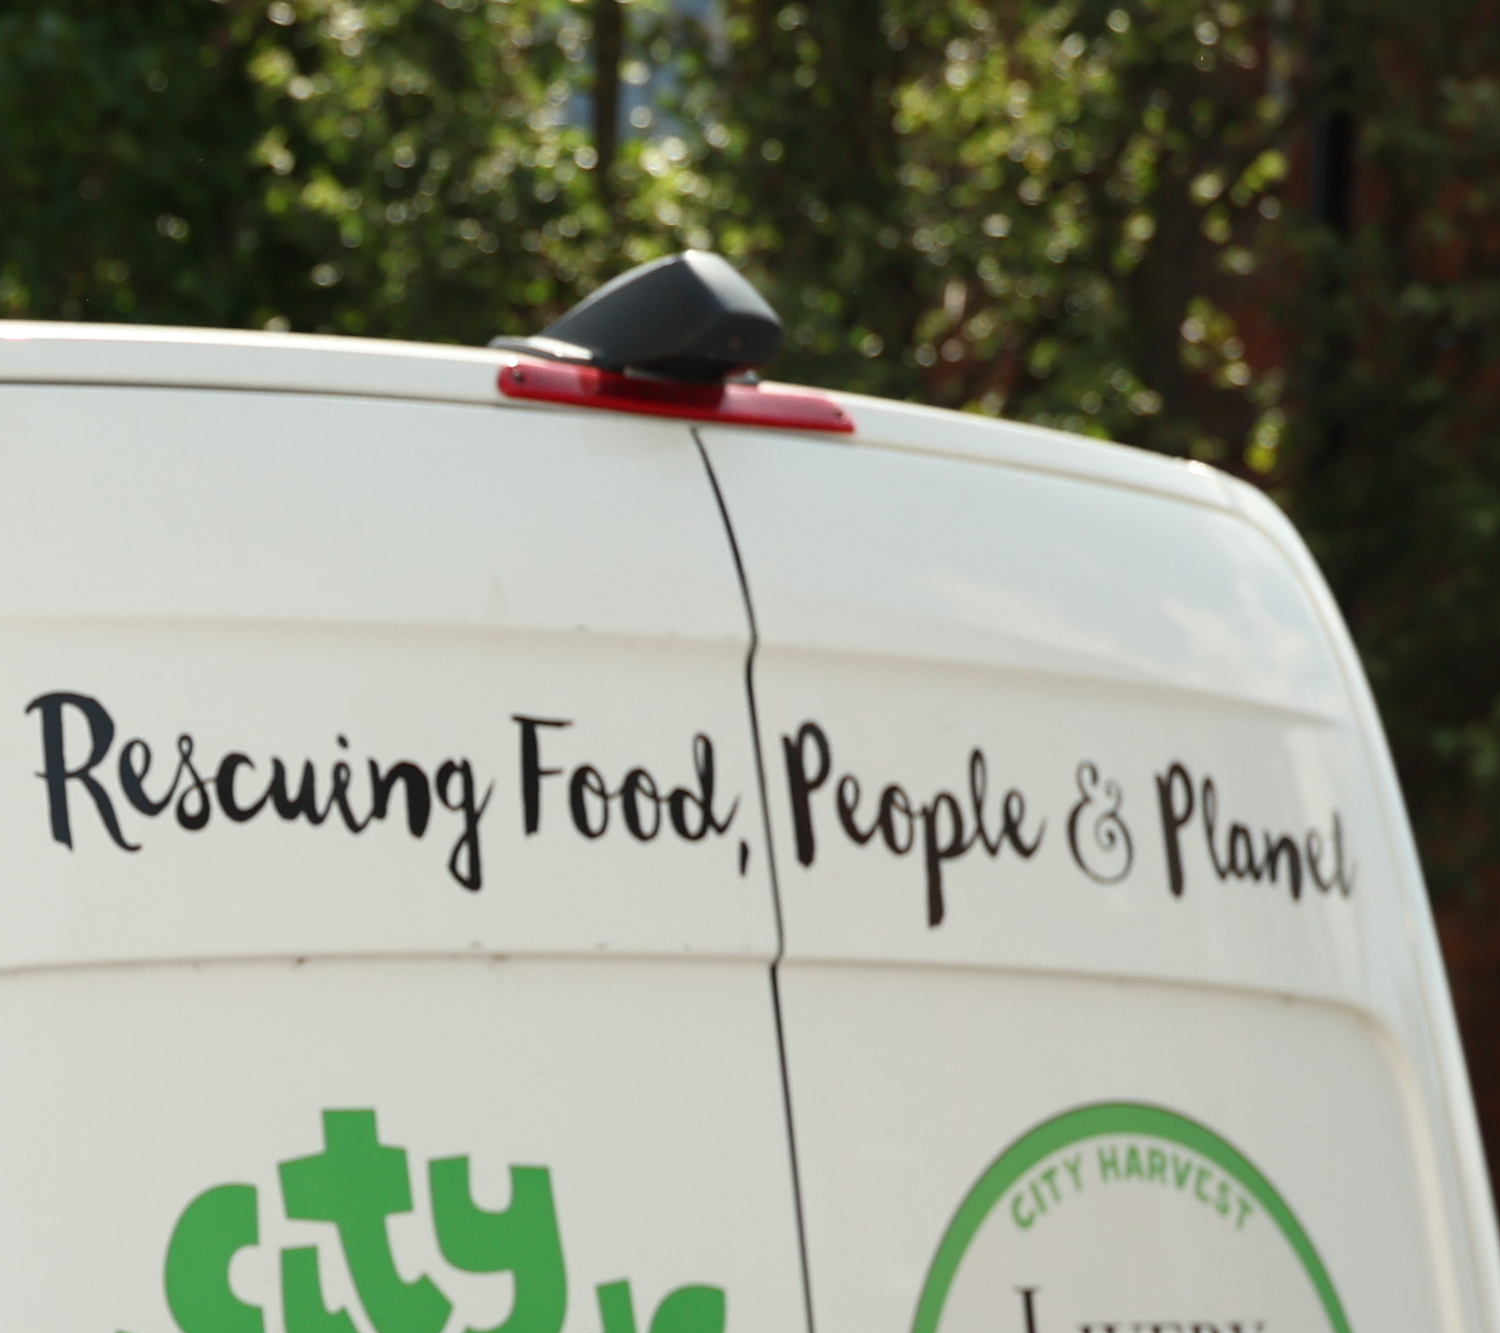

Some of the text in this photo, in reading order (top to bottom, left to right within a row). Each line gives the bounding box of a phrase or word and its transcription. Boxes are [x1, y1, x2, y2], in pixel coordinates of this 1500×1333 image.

[24, 689, 1357, 929] Rescuing Food, People & Planet
[1010, 1144, 1254, 1231] CITY HARVEST
